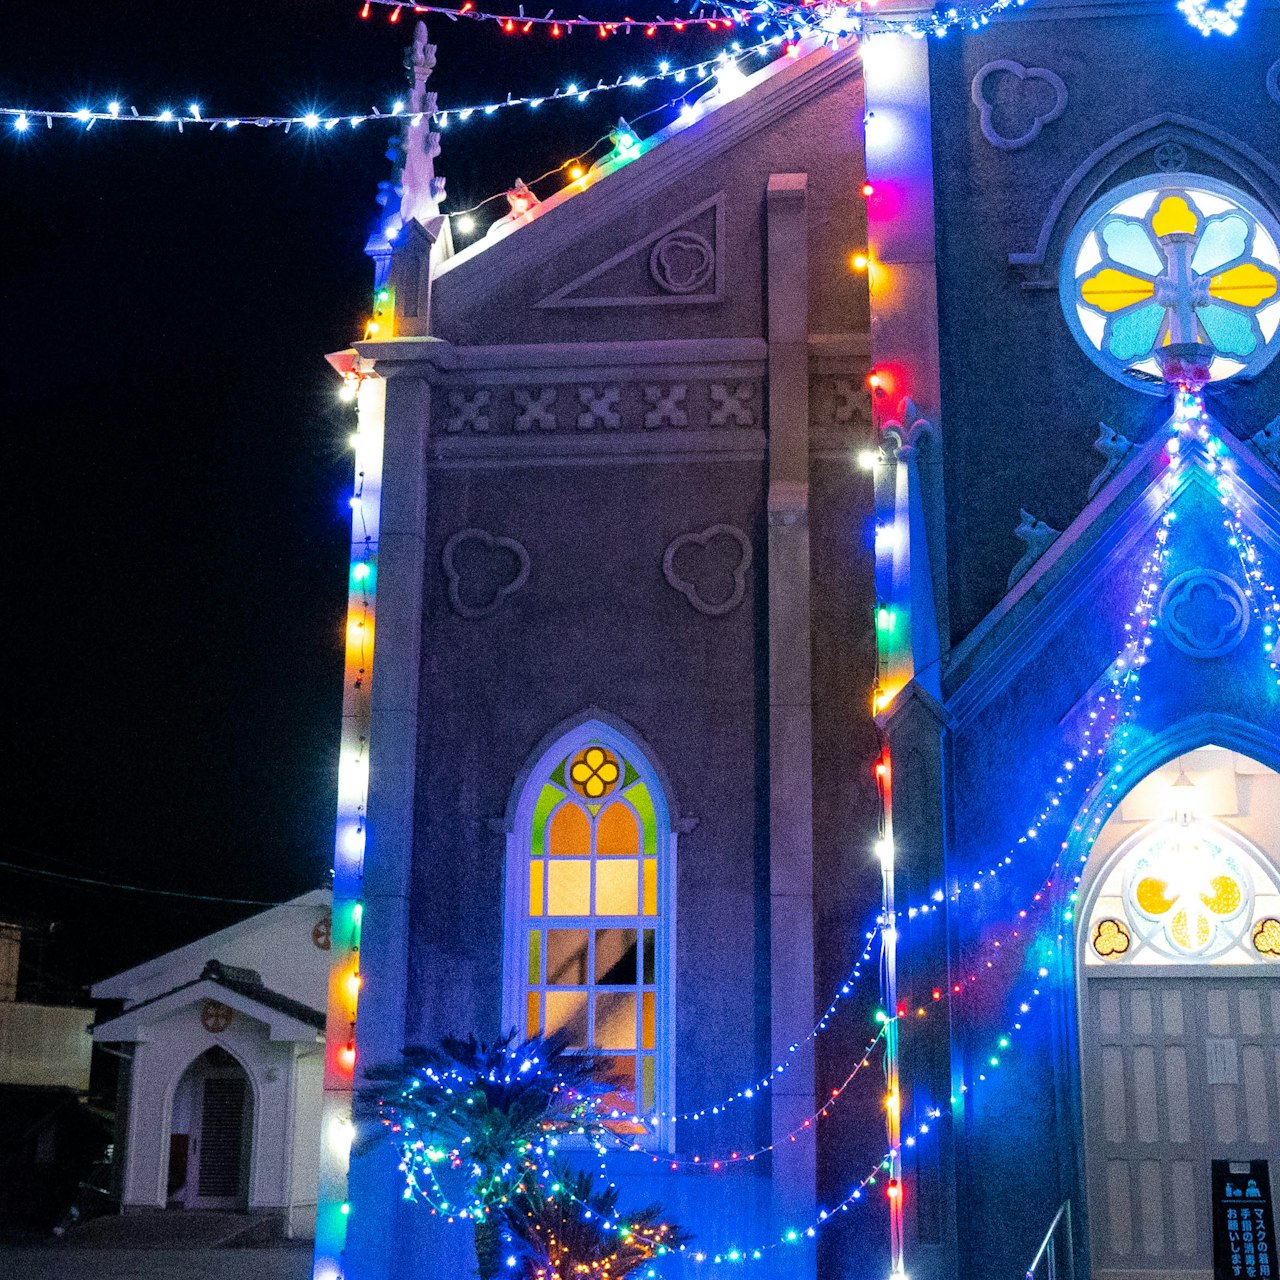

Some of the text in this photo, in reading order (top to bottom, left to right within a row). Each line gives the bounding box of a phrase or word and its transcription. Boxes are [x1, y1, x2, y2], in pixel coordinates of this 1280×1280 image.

[1227, 1208, 1243, 1277] お願いします
